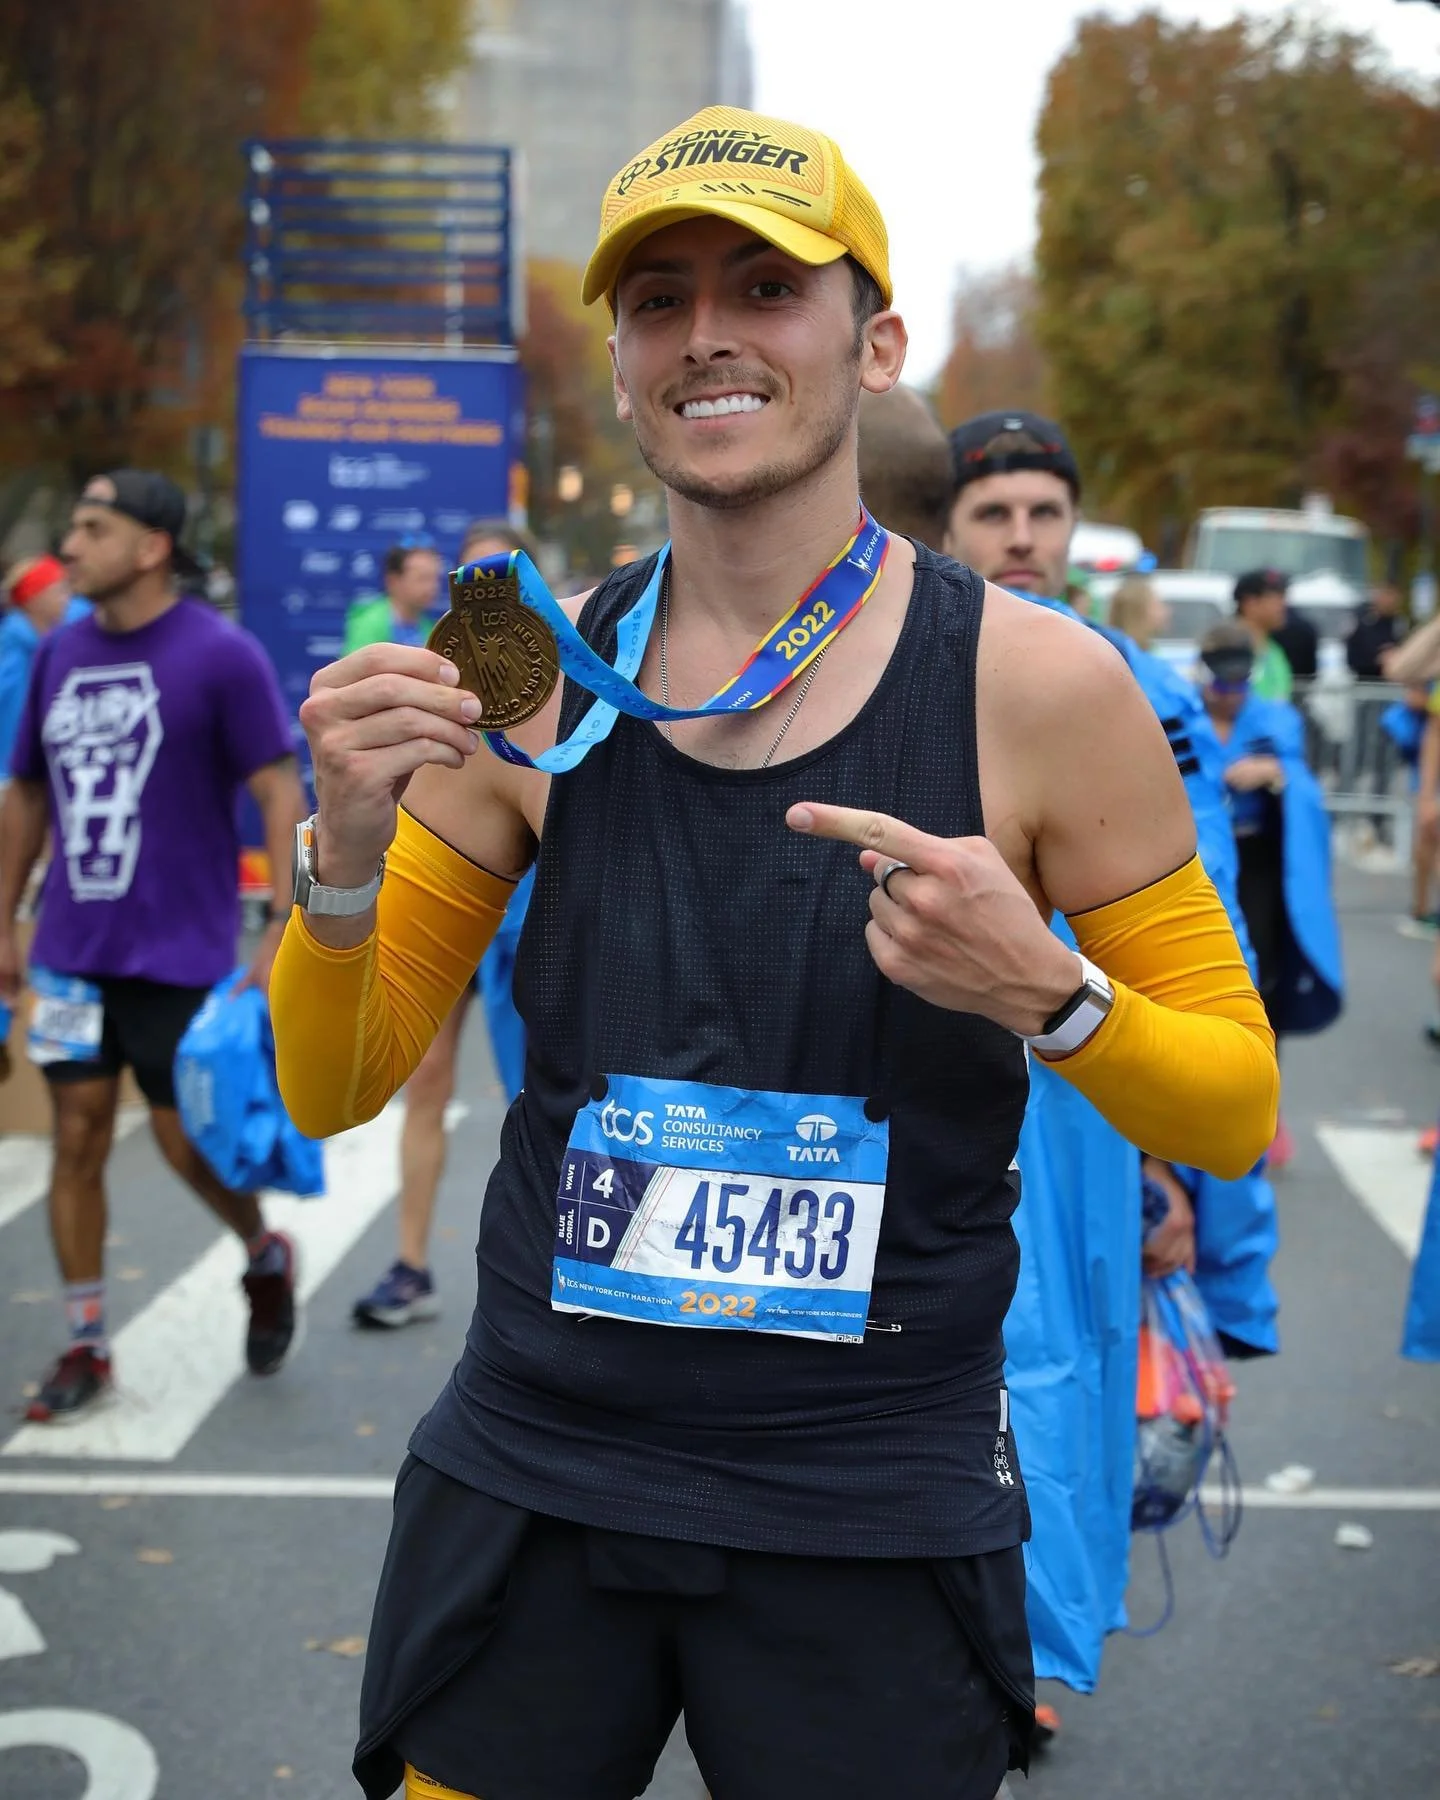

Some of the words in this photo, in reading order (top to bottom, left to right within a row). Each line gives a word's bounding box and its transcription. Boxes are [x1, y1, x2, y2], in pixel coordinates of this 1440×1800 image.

[662, 129, 770, 151] HONEY
[647, 139, 808, 179] STINGER
[464, 586, 507, 601] 2022
[513, 623, 541, 653] NEW
[775, 601, 836, 661] 2022
[521, 657, 542, 697] YORK
[487, 698, 520, 716] CITY
[665, 1104, 707, 1119] TATA
[662, 1120, 762, 1141] CONSULTANCY
[661, 1135, 724, 1152] SERVICES
[786, 1146, 840, 1163] TATA
[566, 1164, 576, 1190] WAVE
[592, 1168, 615, 1199] 4
[558, 1214, 566, 1239] BLUE
[565, 1208, 575, 1246] CORRAL
[586, 1217, 611, 1248] D
[674, 1181, 854, 1280] 45433
[579, 1283, 594, 1291] NEW
[595, 1286, 613, 1296] YORK
[614, 1290, 630, 1299] CITY
[631, 1293, 673, 1306] MARATHON
[680, 1291, 757, 1318] 2022
[820, 1310, 836, 1318] ROAD
